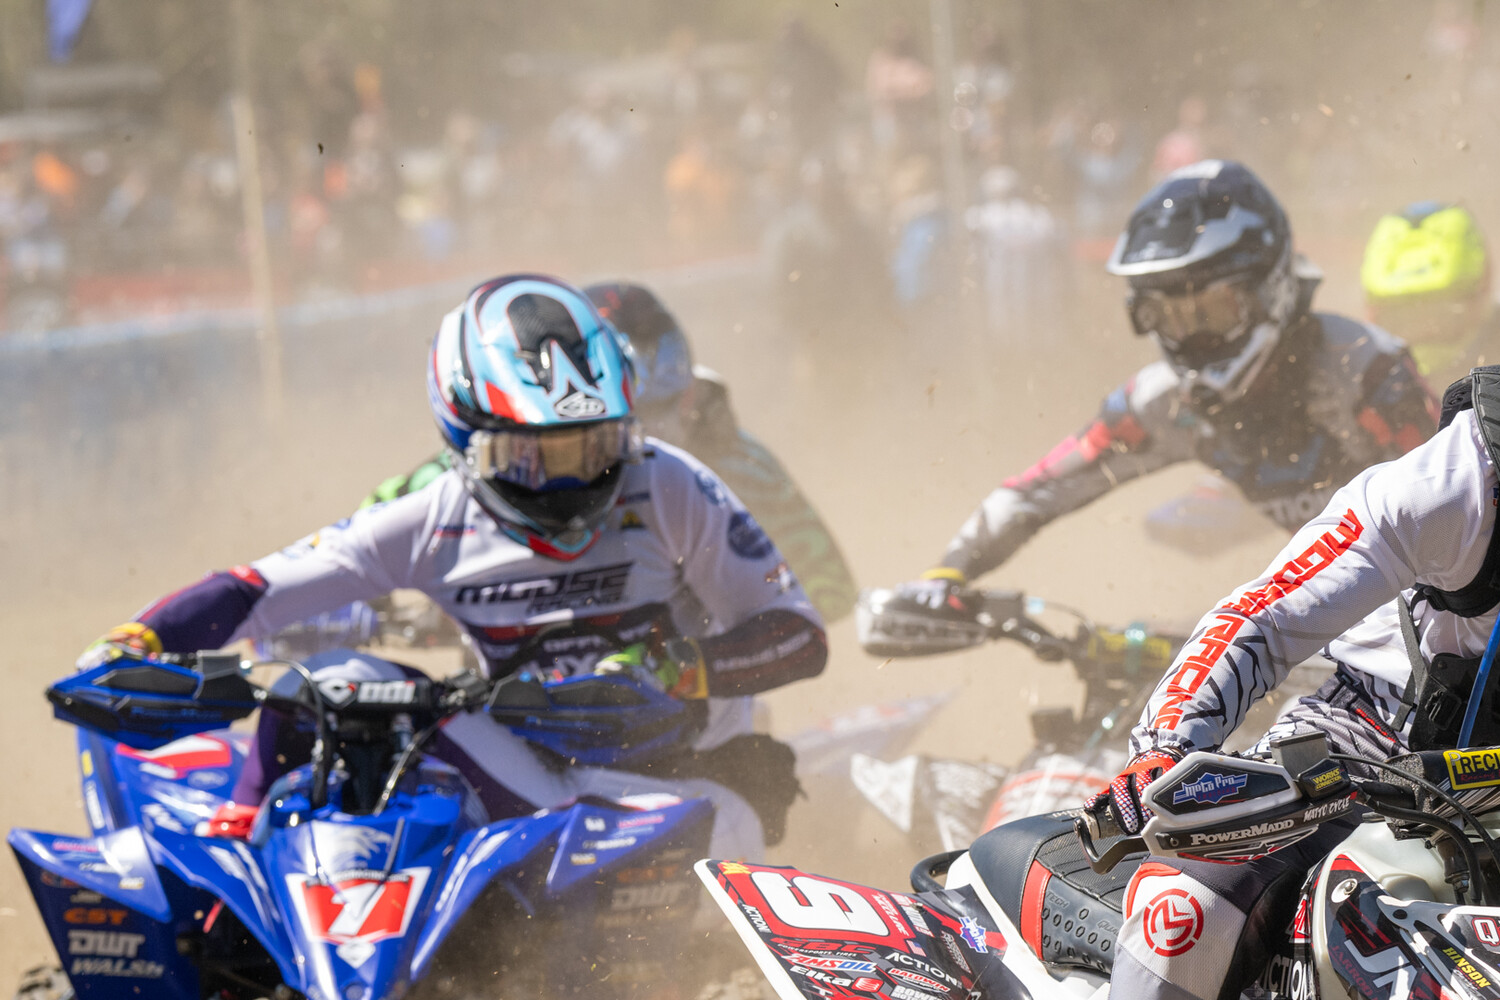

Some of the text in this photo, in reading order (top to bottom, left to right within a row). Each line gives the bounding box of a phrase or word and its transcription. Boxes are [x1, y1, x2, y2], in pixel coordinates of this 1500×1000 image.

[455, 562, 636, 605] MOOSE
[1312, 768, 1340, 784] WORKS
[1316, 775, 1342, 790] CONNECTION
[1303, 797, 1351, 823] MATTO CYCLE
[328, 881, 387, 937] 1
[751, 871, 890, 937] 9
[63, 907, 128, 925] CST
[68, 930, 146, 958] DWT
[770, 937, 877, 955] GBC
[777, 943, 857, 958] POWERSPORTS TIRES
[71, 958, 165, 979] WALSH
[782, 954, 877, 973] AMSOIL
[885, 951, 957, 987] ACTION
[1443, 947, 1492, 988] HINSON
[789, 965, 855, 987] Elka
[888, 968, 950, 993] BALDWIN
